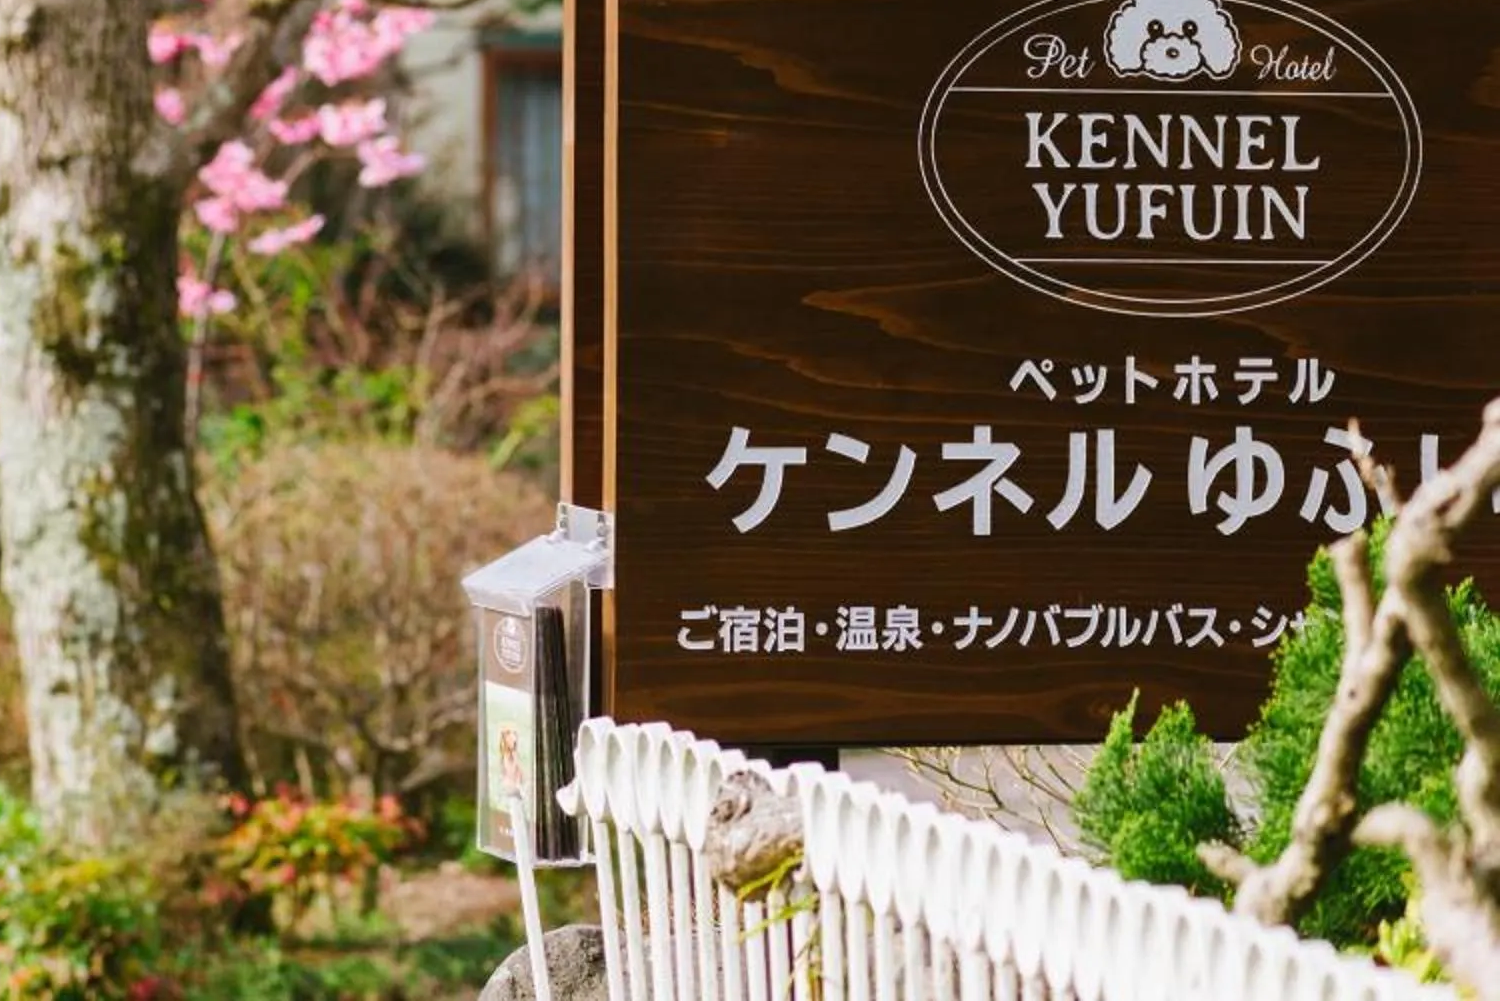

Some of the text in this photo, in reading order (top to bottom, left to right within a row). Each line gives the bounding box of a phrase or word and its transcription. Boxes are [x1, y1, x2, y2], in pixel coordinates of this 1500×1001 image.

[1023, 33, 1337, 81] Pet Hotel
[1025, 112, 1320, 171] KENNEL
[1032, 182, 1309, 241] YUFUIN
[1009, 355, 1335, 405] ペットホテル
